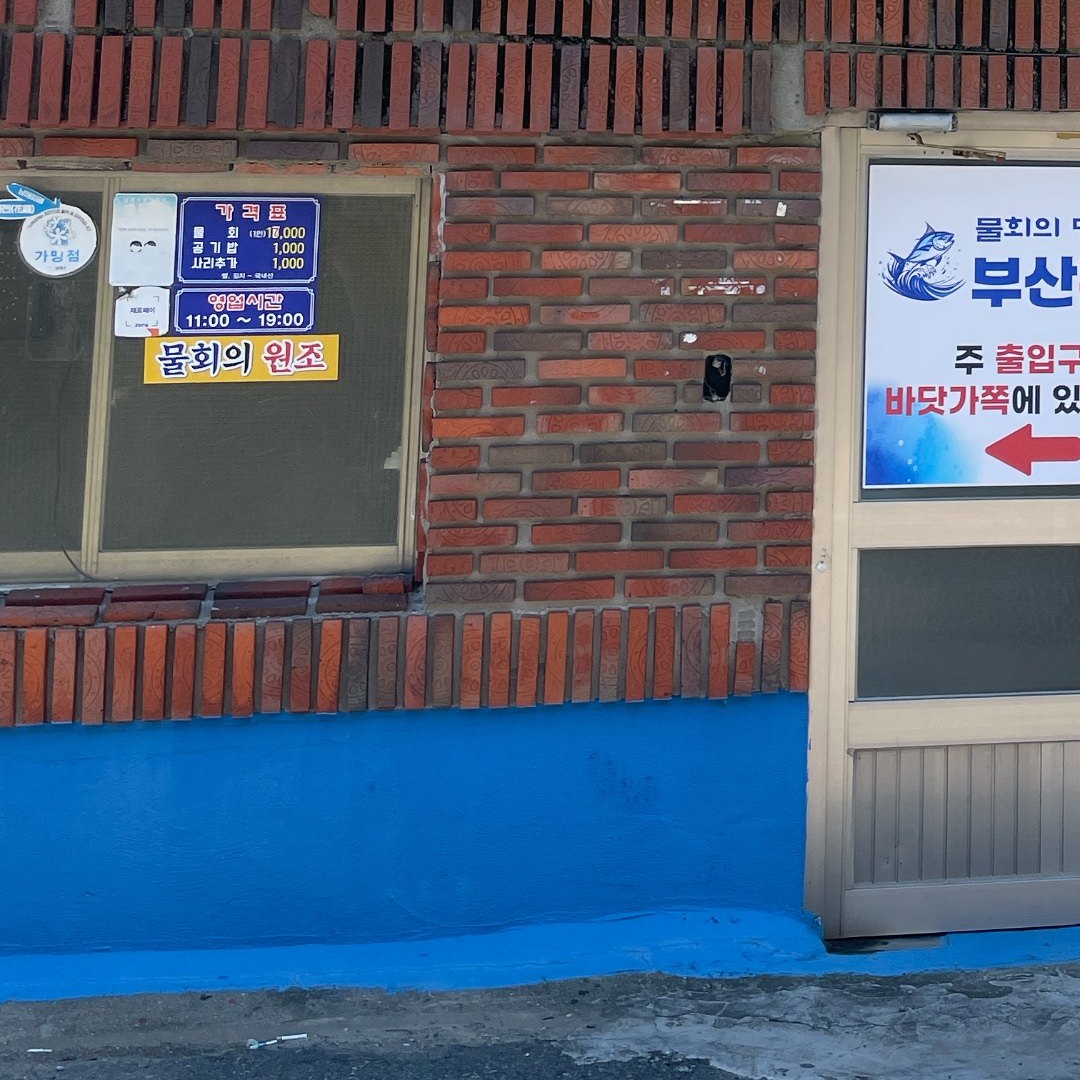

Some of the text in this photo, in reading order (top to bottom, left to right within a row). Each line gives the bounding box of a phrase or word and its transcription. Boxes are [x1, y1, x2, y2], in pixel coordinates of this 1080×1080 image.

[975, 216, 1060, 243] 물회의
[272, 242, 305, 256] 1,000
[191, 257, 304, 271] 사리추가 1,000
[254, 272, 274, 280] 국내산
[208, 293, 284, 312] 영업시간
[186, 313, 230, 328] 11:00
[258, 312, 304, 327] 19:00
[156, 339, 328, 379] 물회의 원조
[954, 344, 984, 375] 주
[885, 384, 1041, 416] 바닷가쪽에
